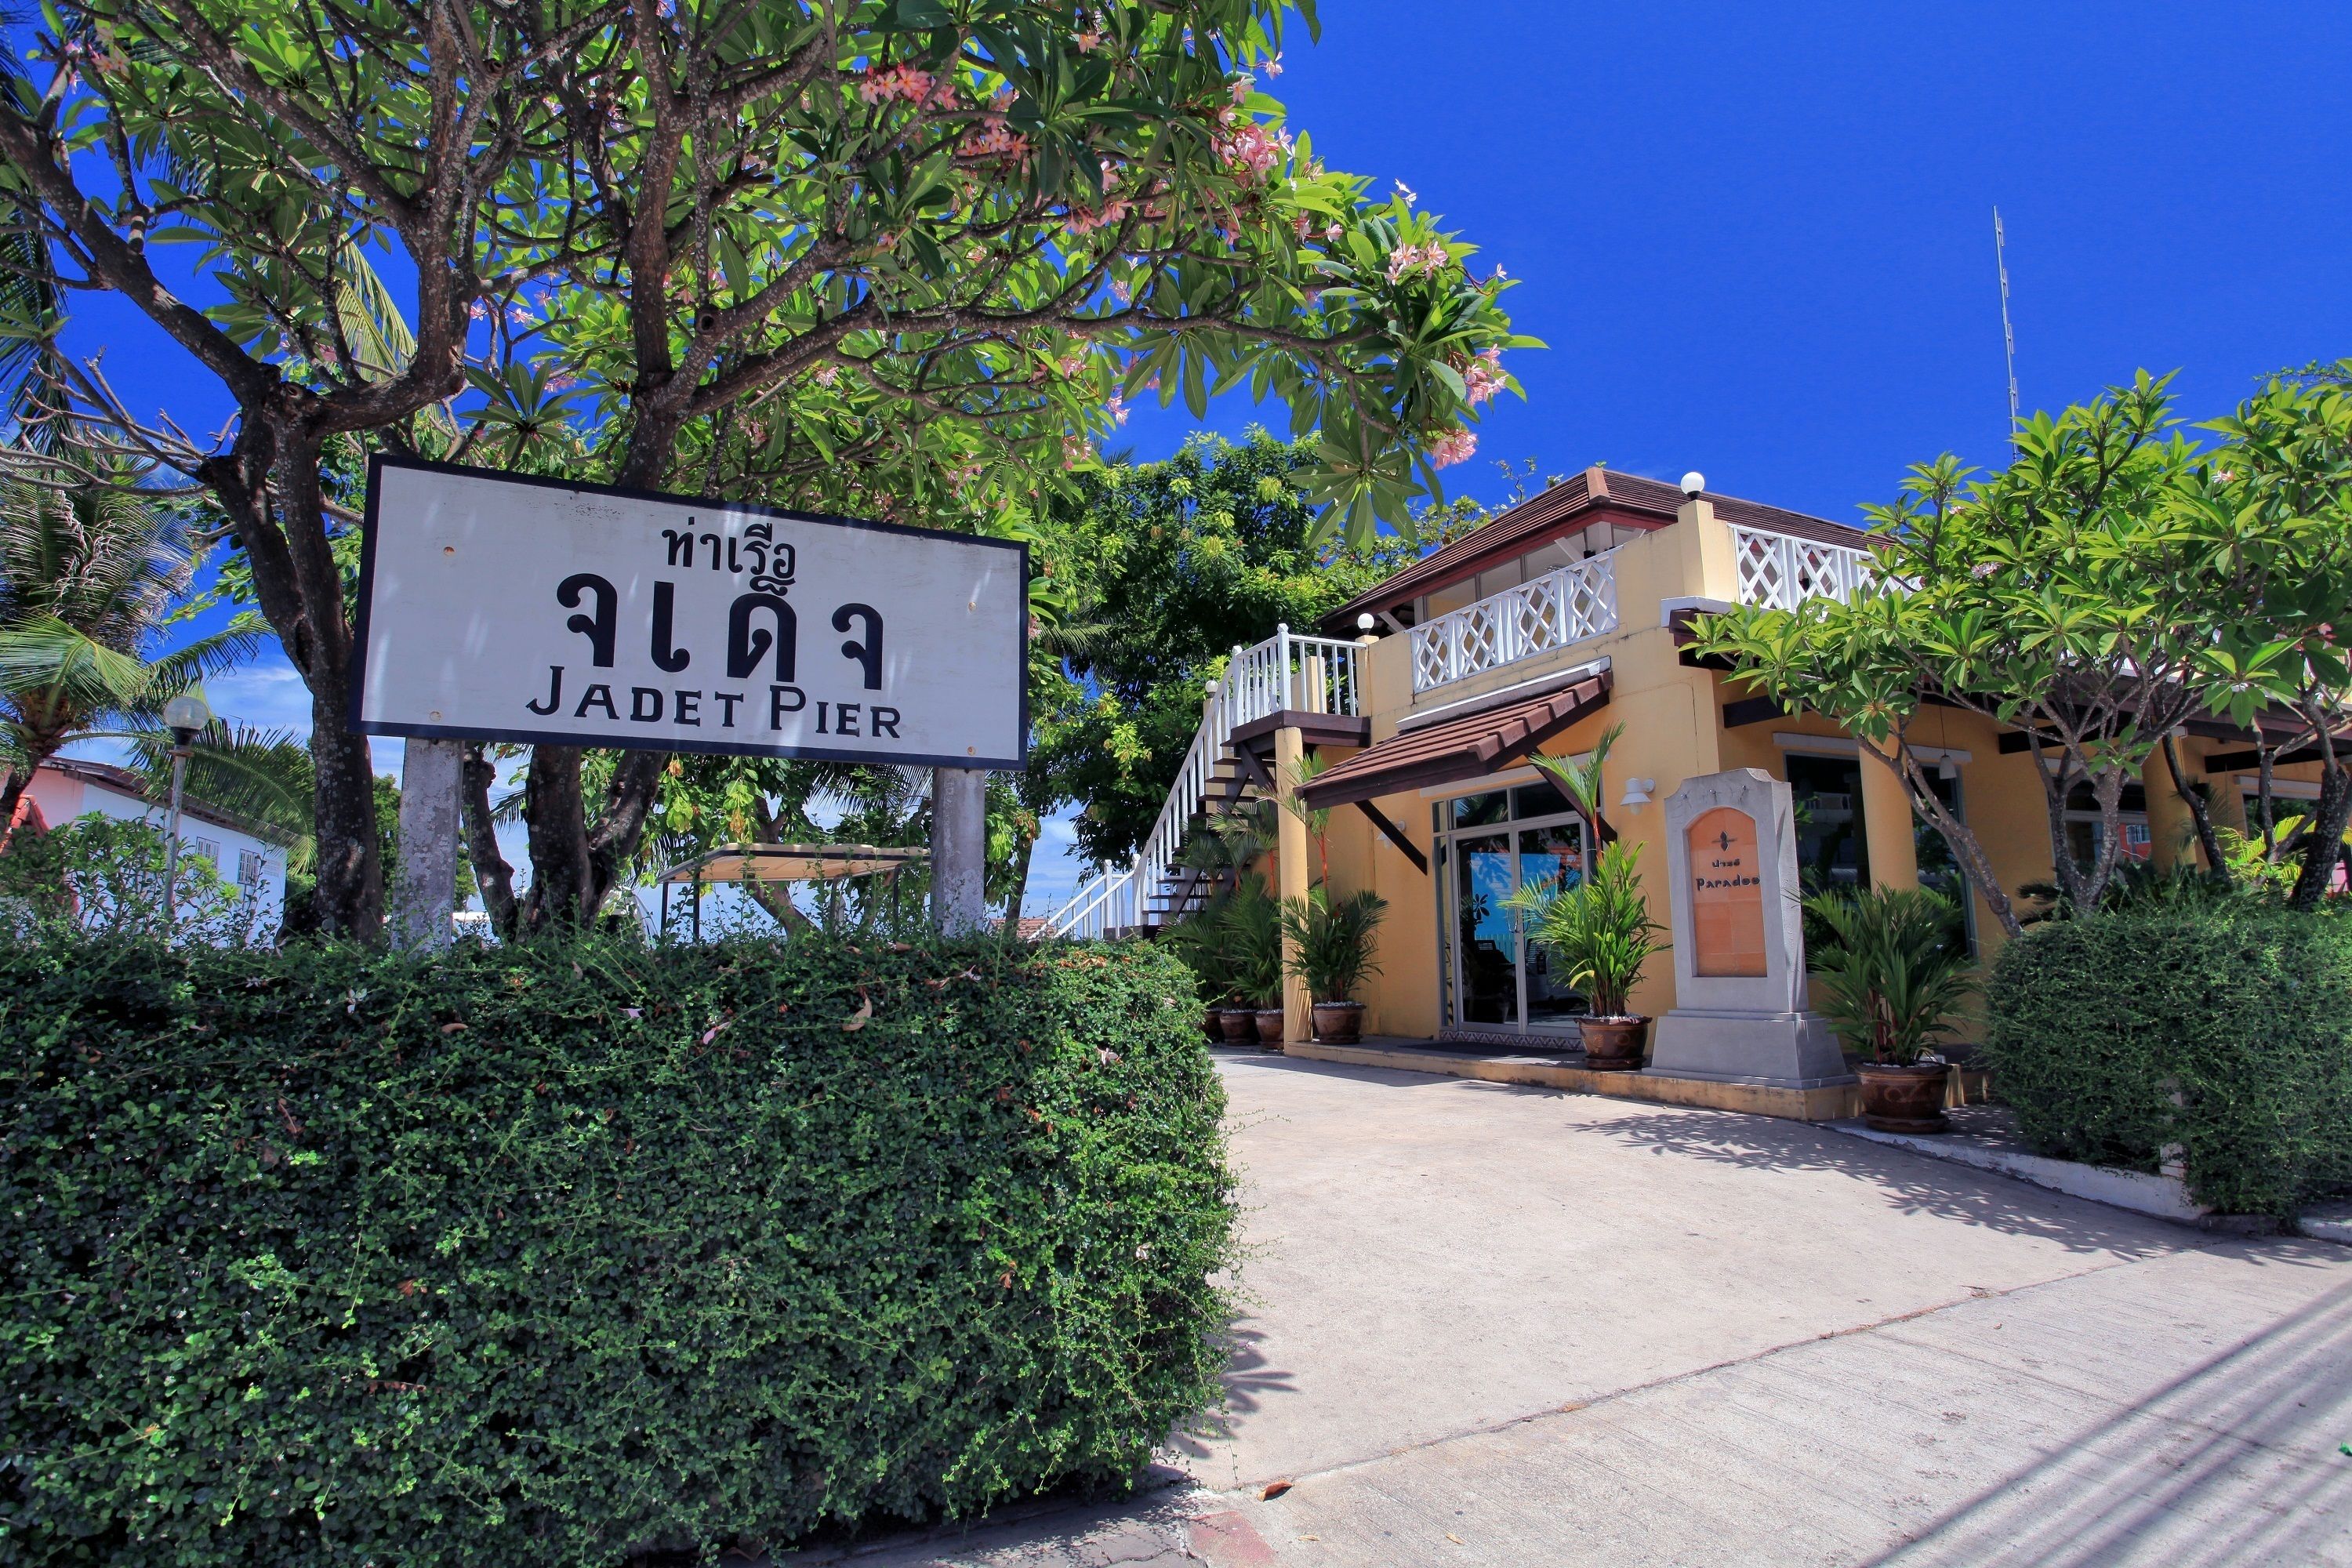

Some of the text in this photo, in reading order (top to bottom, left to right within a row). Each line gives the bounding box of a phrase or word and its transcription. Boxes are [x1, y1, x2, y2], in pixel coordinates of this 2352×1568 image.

[661, 516, 796, 579] ท่าเรือ
[556, 572, 884, 691] จเด็จ
[525, 665, 902, 739] JADET PIER
